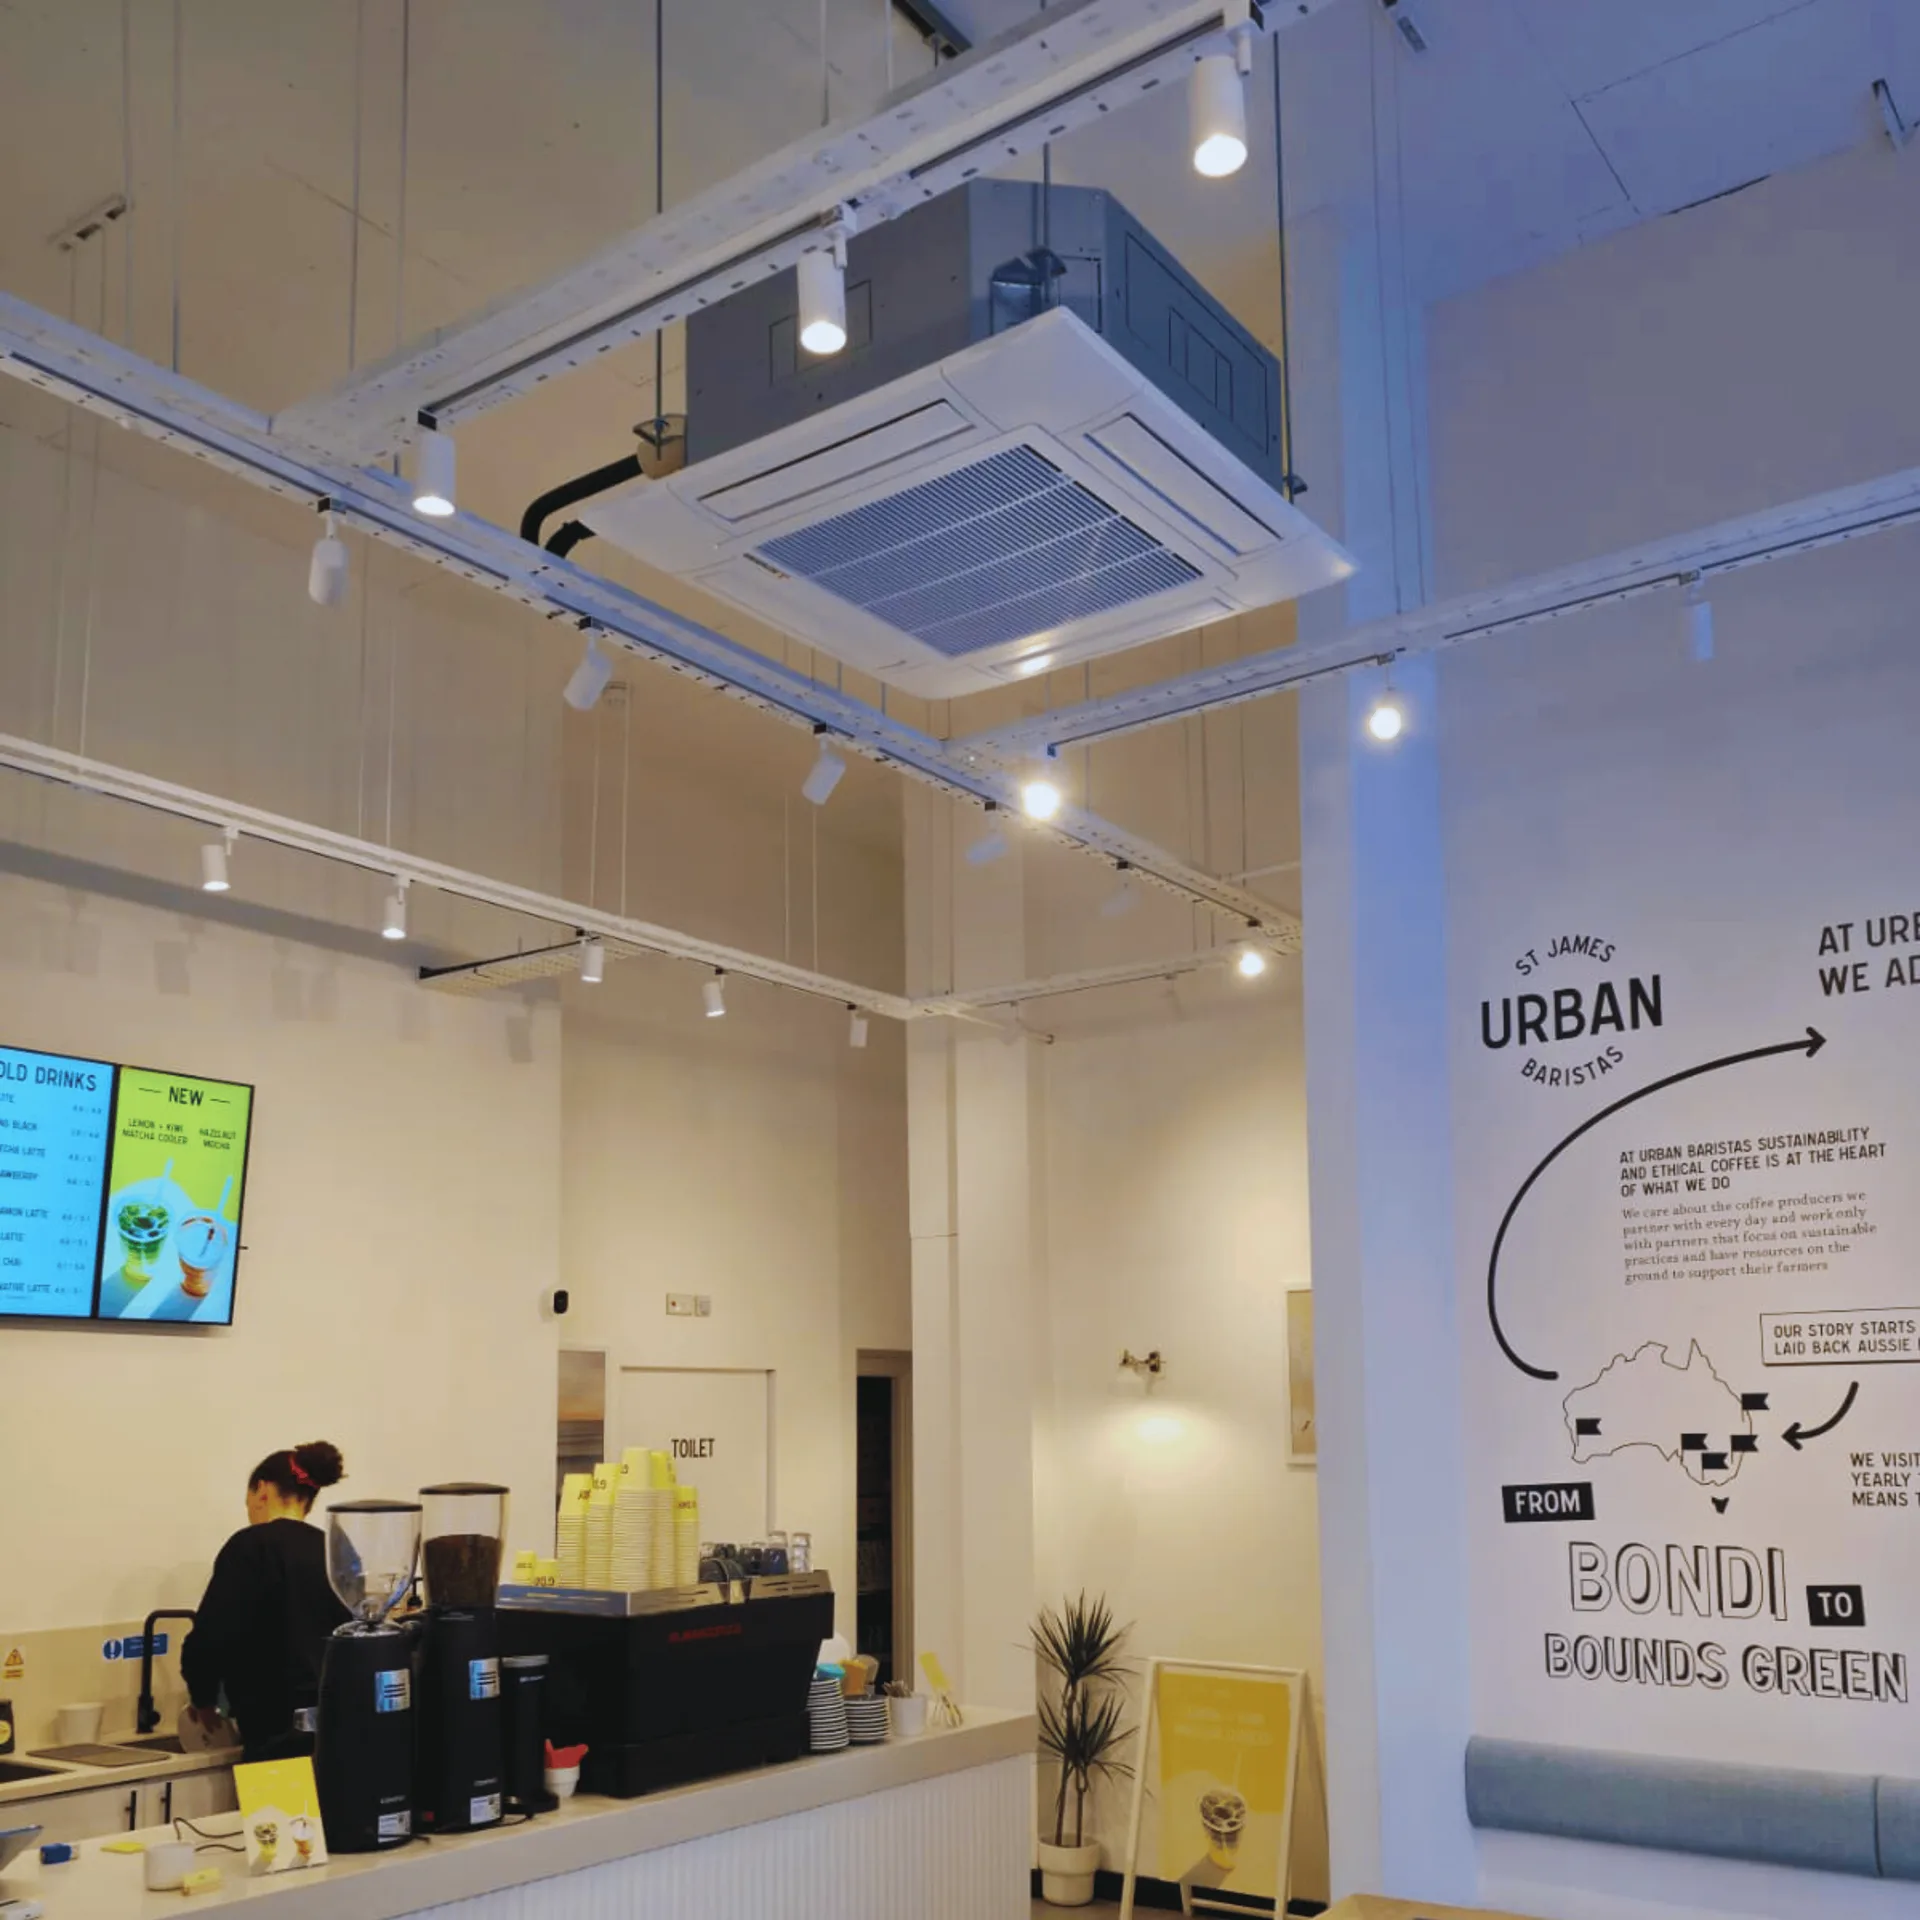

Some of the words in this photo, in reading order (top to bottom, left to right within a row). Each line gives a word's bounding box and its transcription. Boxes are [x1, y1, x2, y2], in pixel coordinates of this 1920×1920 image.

[1819, 922, 1854, 956] AT
[1515, 949, 1540, 976] ST
[1547, 934, 1616, 963] JAMES
[1818, 962, 1870, 997] WE
[1481, 974, 1662, 1049] URBAN
[35, 1066, 97, 1092] DRINKS
[1520, 1045, 1624, 1087] BARISTAS
[169, 1085, 204, 1107] NEW
[122, 1128, 155, 1140] MATCHA
[158, 1134, 188, 1145] COOLER
[128, 1118, 155, 1129] LEMON
[1620, 1150, 1635, 1164] AT
[1639, 1145, 1682, 1162] URBAN
[1687, 1139, 1752, 1158] BARISTAS
[1757, 1126, 1870, 1151] SUSTAINABILITY
[1620, 1166, 1646, 1180] AND
[1652, 1161, 1705, 1178] ETHICAL
[1711, 1155, 1760, 1173] COFFEE
[1766, 1154, 1780, 1168] IS
[1786, 1151, 1802, 1165] AT
[1808, 1148, 1835, 1163] THE
[1839, 1142, 1886, 1161] HEART
[1621, 1183, 1637, 1198] OF
[1642, 1180, 1679, 1196] WHAT
[1686, 1178, 1706, 1192] WE
[1711, 1176, 1730, 1190] DO
[1622, 1208, 1640, 1219] We
[1643, 1208, 1669, 1219] care
[1672, 1202, 1708, 1216] about
[1711, 1201, 1732, 1212] the
[1735, 1196, 1774, 1211] coffee
[1778, 1193, 1843, 1210] producers
[1846, 1192, 1867, 1201] we
[1623, 1223, 1670, 1239] partner
[1673, 1218, 1702, 1231] with
[1705, 1218, 1741, 1230] every
[1744, 1213, 1767, 1228] day
[1772, 1210, 1796, 1224] and
[1800, 1208, 1834, 1222] work
[1835, 1205, 1867, 1220] only
[1624, 1238, 1652, 1251] with
[1655, 1236, 1708, 1252] partners
[1712, 1232, 1740, 1244] that
[1743, 1229, 1776, 1243] focus
[1780, 1230, 1798, 1240] on
[1802, 1221, 1877, 1239] sustainable
[1624, 1255, 1679, 1270] practices
[1682, 1251, 1705, 1262] and
[1710, 1249, 1738, 1260] have
[1743, 1246, 1804, 1258] resources
[1807, 1245, 1824, 1255] on
[1828, 1241, 1850, 1253] the
[1624, 1269, 1668, 1286] ground
[1673, 1269, 1685, 1279] to
[1688, 1266, 1737, 1281] support
[1740, 1263, 1773, 1275] their
[1776, 1261, 1828, 1273] farmers
[1774, 1324, 1802, 1338] OUR
[1808, 1322, 1854, 1337] STORY
[1860, 1320, 1916, 1336] STARTS
[1774, 1341, 1806, 1356] LAID
[1812, 1340, 1850, 1354] BACK
[1859, 1338, 1912, 1353] AUSSIE
[671, 1438, 715, 1459] TOILET
[1850, 1452, 1874, 1467] WE
[1881, 1452, 1920, 1467] VISIT
[1851, 1472, 1911, 1487] YEARLY
[1515, 1489, 1581, 1515] FROM
[1852, 1491, 1908, 1507] MEANS
[1569, 1541, 1788, 1621] BONDI
[1817, 1591, 1852, 1618] TO
[1545, 1633, 1729, 1690] BOUNDS
[1742, 1645, 1908, 1703] GREEN
